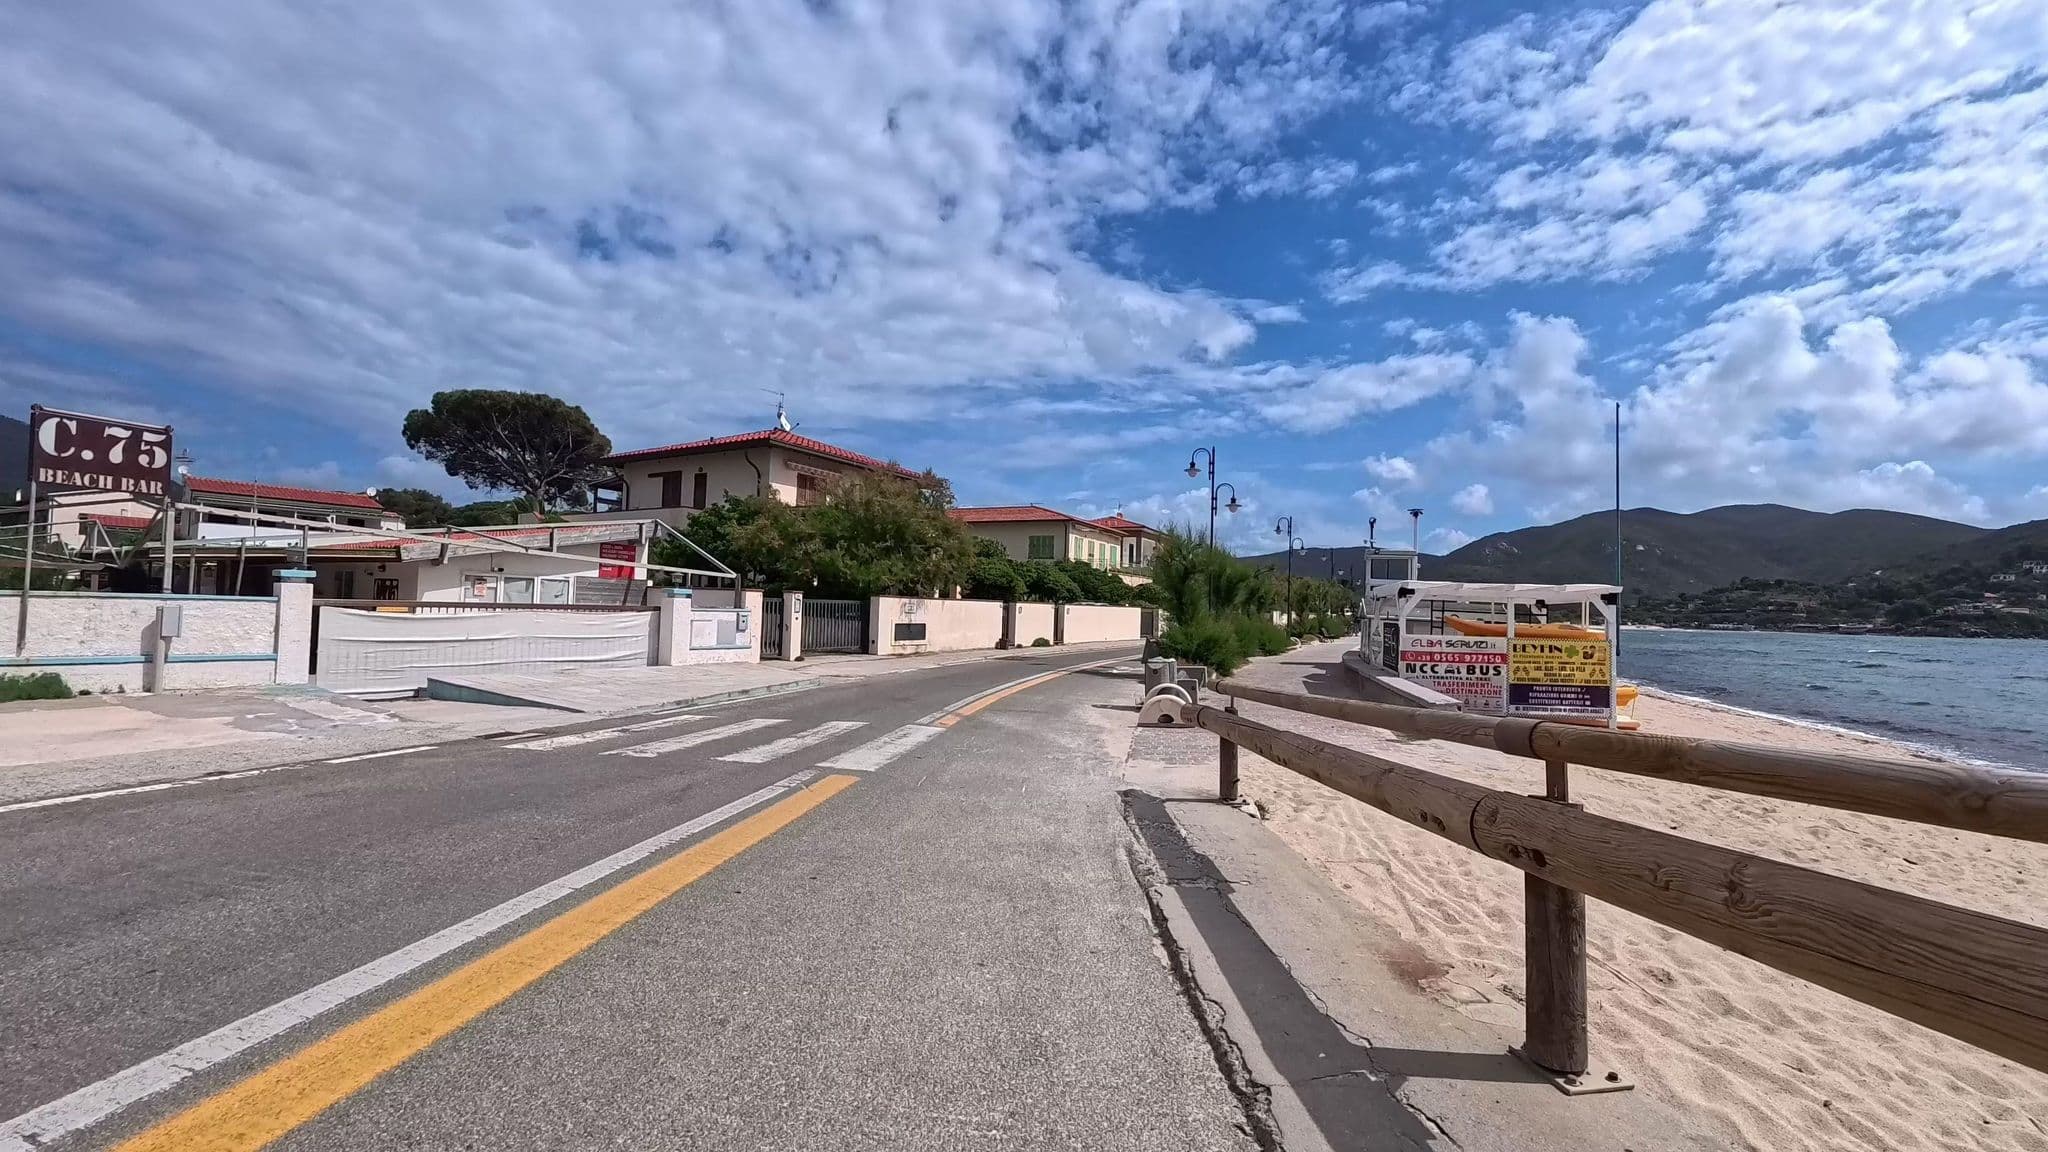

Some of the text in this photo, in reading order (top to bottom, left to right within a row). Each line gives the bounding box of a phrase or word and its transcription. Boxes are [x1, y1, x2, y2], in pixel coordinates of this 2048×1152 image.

[39, 417, 168, 469] C.75
[39, 467, 163, 495] BEACH BAR
[1411, 638, 1442, 648] ELBA
[1434, 653, 1460, 662] 0565
[1405, 663, 1502, 677] NCC BUS
